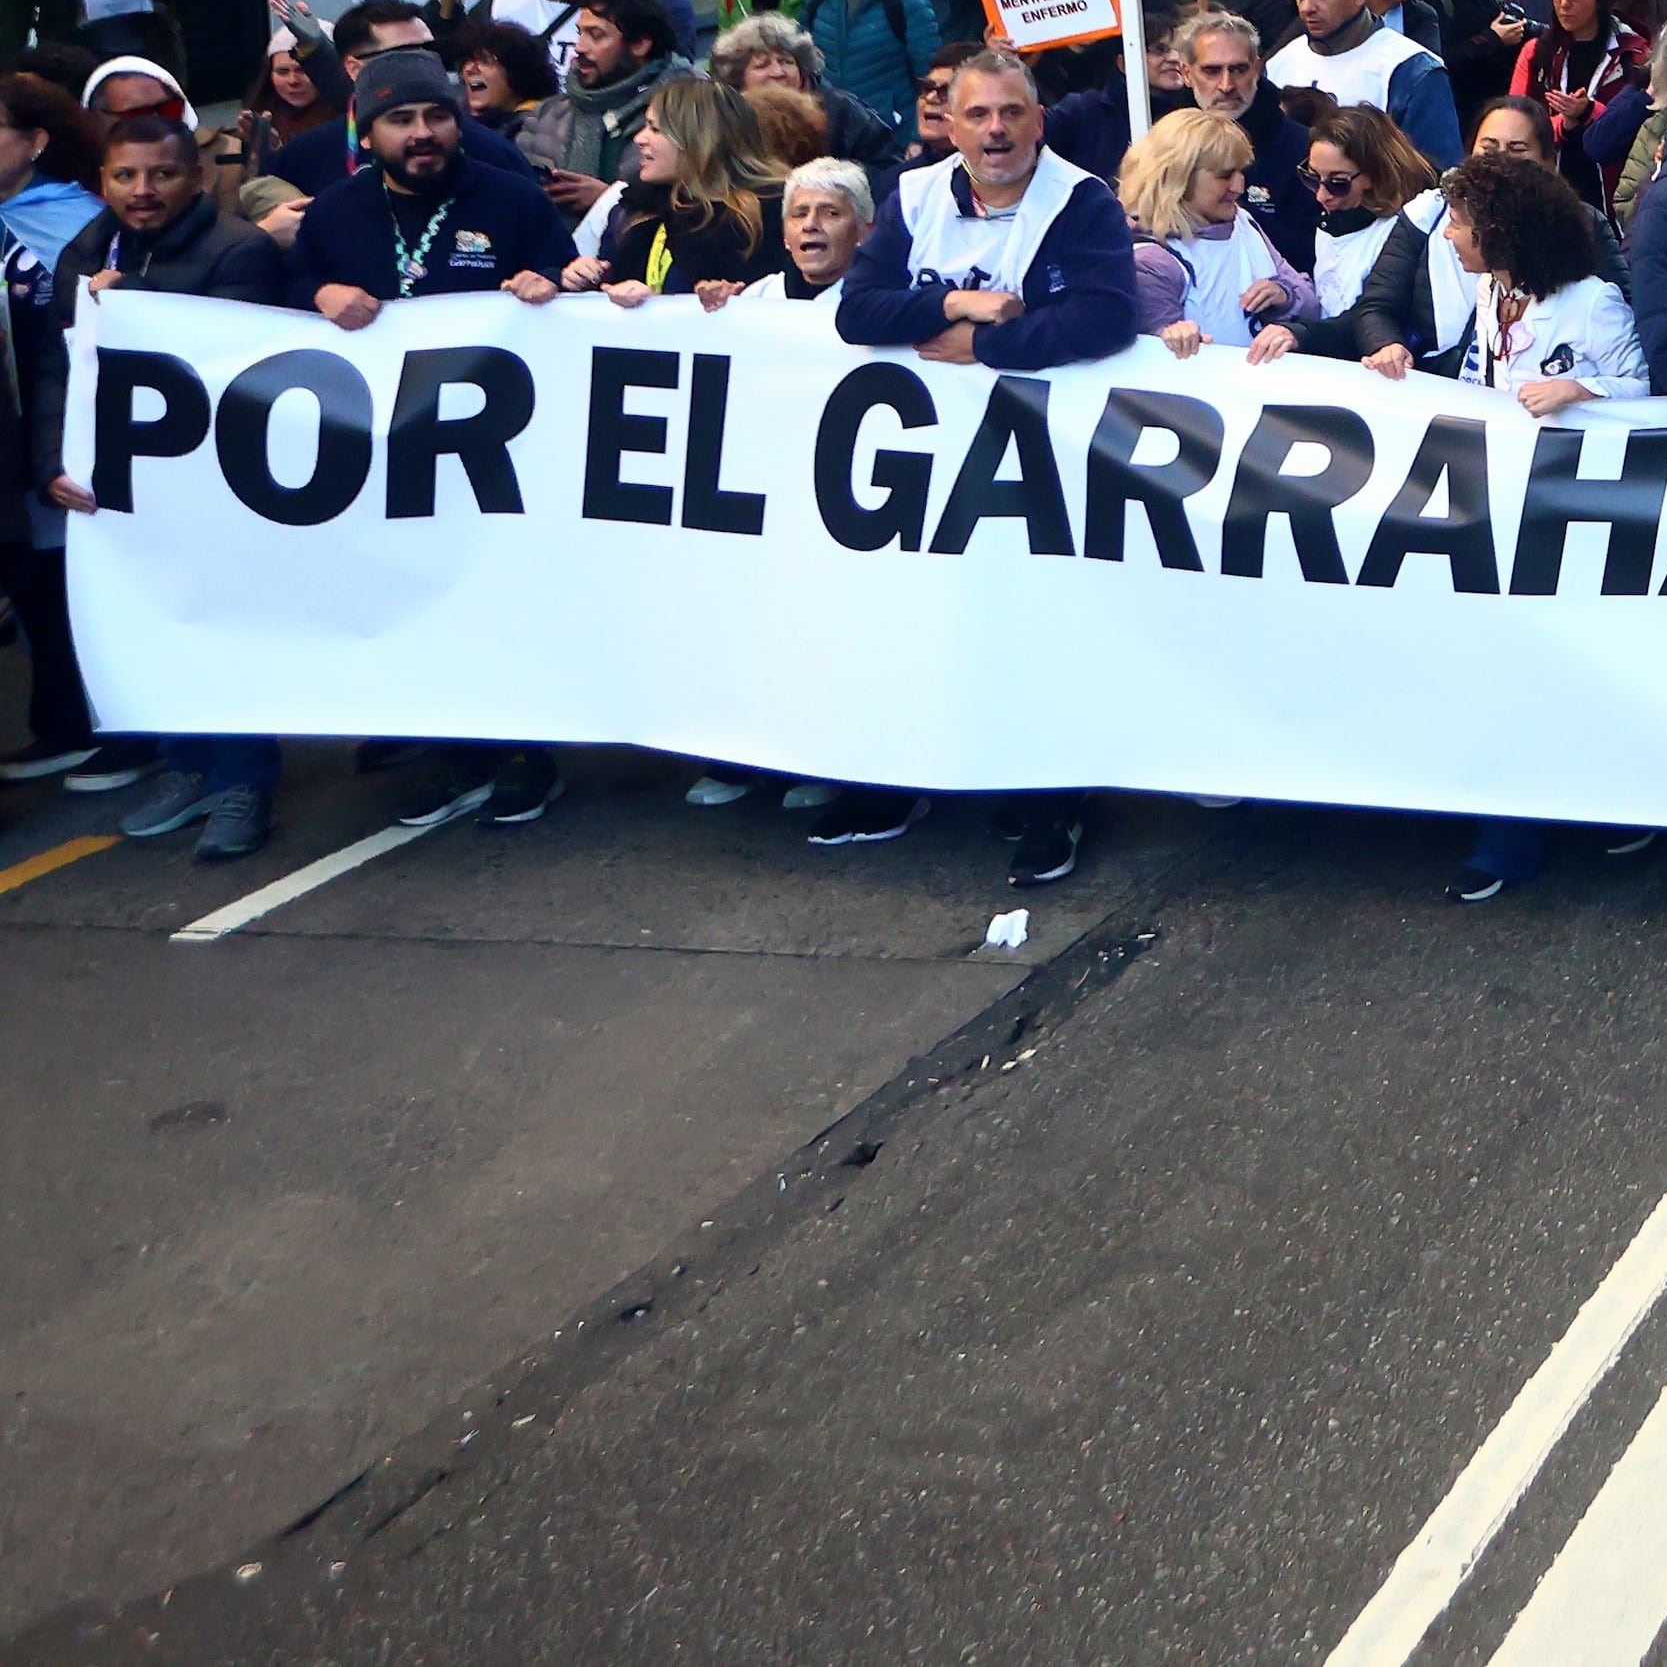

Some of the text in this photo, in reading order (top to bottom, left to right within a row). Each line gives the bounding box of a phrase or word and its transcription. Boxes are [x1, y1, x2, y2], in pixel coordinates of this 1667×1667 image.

[1022, 0, 1088, 24] ENFERMO
[91, 345, 536, 527] POR
[581, 345, 767, 537] EL
